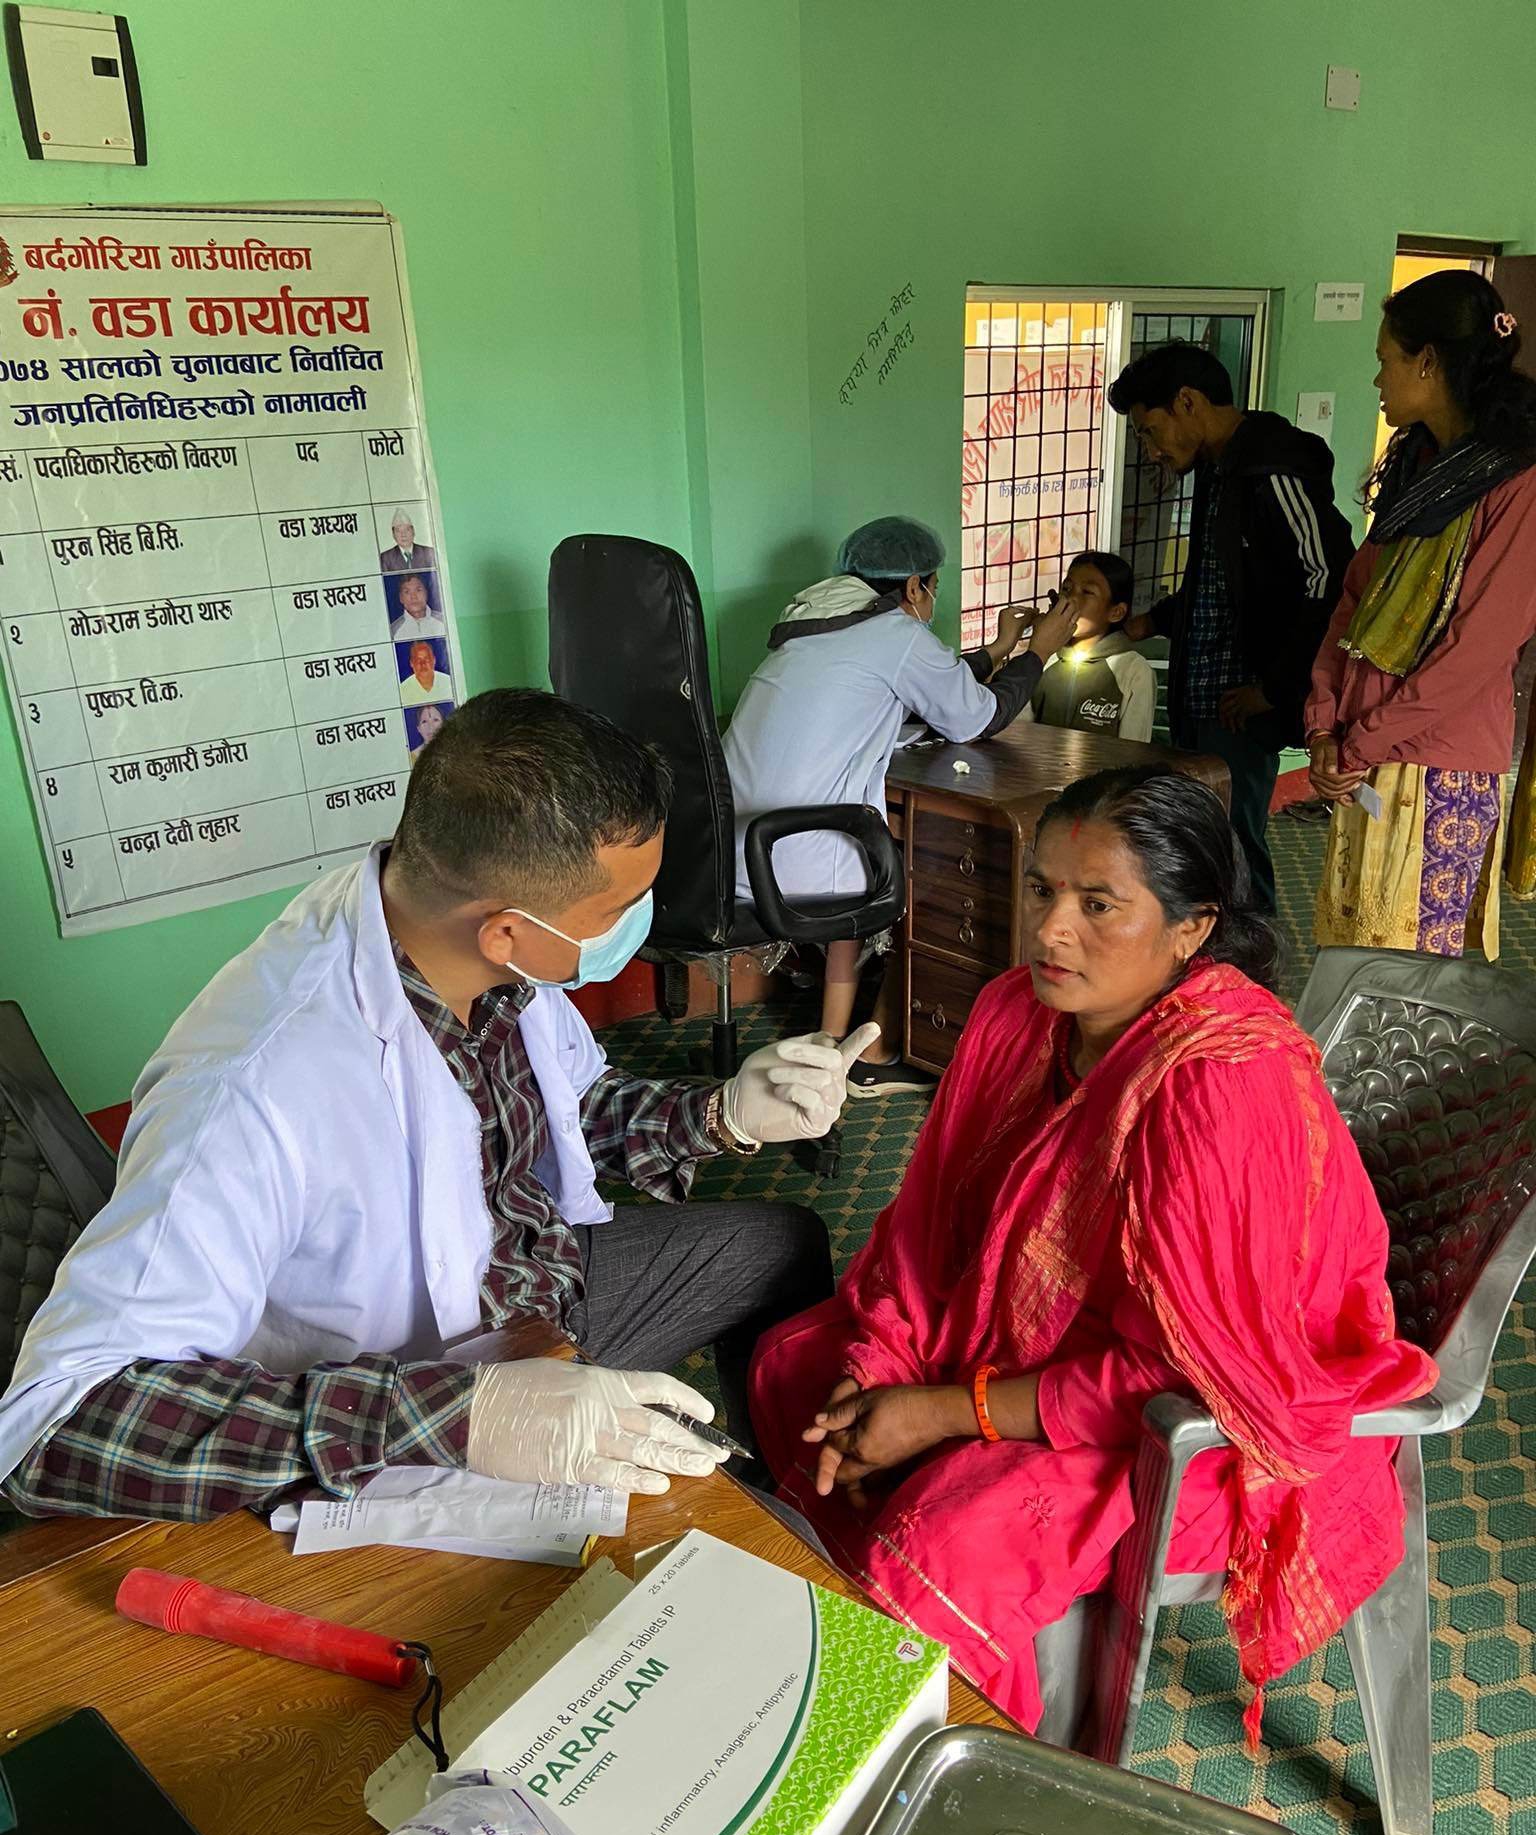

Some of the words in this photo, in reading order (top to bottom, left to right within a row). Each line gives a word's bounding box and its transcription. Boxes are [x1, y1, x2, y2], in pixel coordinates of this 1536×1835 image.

[22, 236, 161, 271] बर्दगोरिया
[168, 238, 313, 271] गाउँपालिका
[18, 288, 77, 340] नं.
[89, 297, 174, 338] वडा
[186, 285, 370, 337] कार्यालय
[59, 349, 161, 382] सालको
[170, 353, 282, 382] चुनावबाट
[289, 344, 384, 373] निर्वाचित
[262, 384, 367, 415] नामावली
[182, 441, 238, 469] विवरण
[295, 442, 319, 462] पद
[367, 430, 405, 456] फोटो
[279, 518, 306, 538] वडा
[309, 513, 358, 536] अध्यक्ष
[51, 536, 93, 566] पुरन
[97, 526, 133, 556] सिंह
[292, 590, 319, 610] वडा
[322, 584, 367, 608] सदस्य
[10, 625, 23, 645] २
[68, 610, 141, 637] भोजराम
[304, 659, 330, 679] वडा
[333, 651, 377, 676] सदस्य
[28, 702, 41, 724] ३
[85, 687, 137, 718] पुष्कर
[315, 725, 341, 745] वडा
[343, 717, 386, 741] सदस्य
[107, 761, 142, 785] राम
[145, 746, 199, 782] कुमारी
[325, 790, 350, 810] वडा
[353, 780, 396, 805] सदस्य
[62, 848, 74, 869] ५
[118, 830, 161, 854] चन्द्रा
[164, 819, 194, 846] देवी
[196, 814, 242, 843] लुहार
[648, 1584, 661, 1595] 25
[664, 1569, 677, 1580] 20
[672, 1546, 700, 1569] Tablets
[557, 1713, 573, 1726] &
[567, 1650, 635, 1714] Paracetamol
[628, 1616, 668, 1651] Tablets
[661, 1604, 677, 1623] IP
[754, 1672, 799, 1720] Antipyretic
[527, 1657, 670, 1798] PARAFLAM
